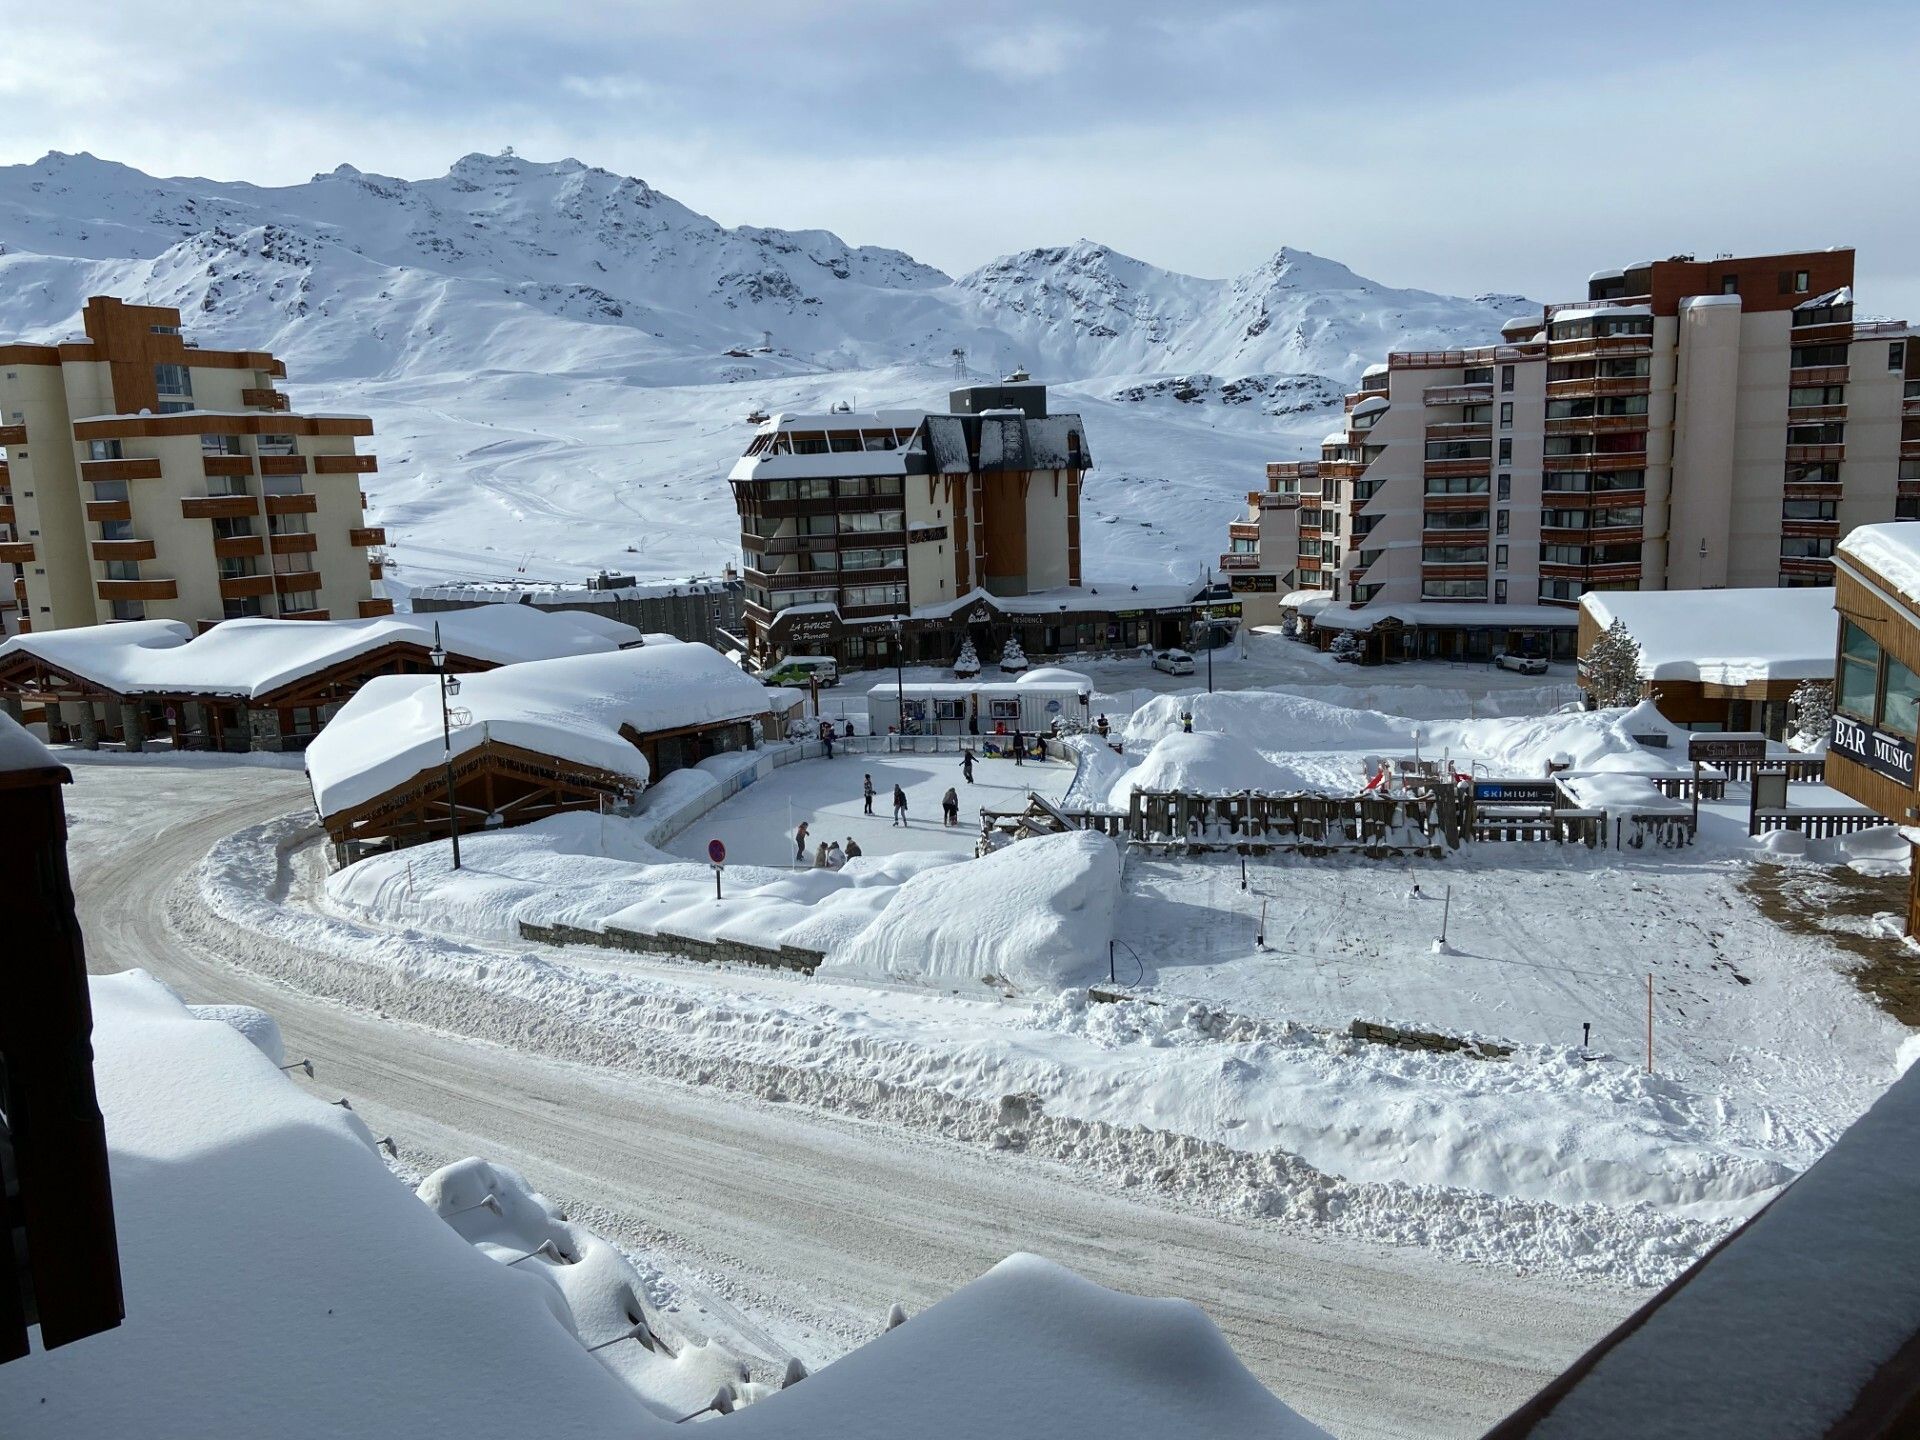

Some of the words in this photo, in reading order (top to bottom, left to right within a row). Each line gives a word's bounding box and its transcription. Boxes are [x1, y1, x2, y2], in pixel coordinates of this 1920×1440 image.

[1155, 605, 1192, 616] Supermarket
[1013, 616, 1043, 624] RESIDENCE
[789, 623, 801, 632] LA
[803, 621, 832, 630] PAUSE
[924, 621, 944, 629] HOTEL
[1834, 719, 1866, 756] BAR
[1874, 738, 1913, 772] MUSIC
[1483, 790, 1536, 798] SKIMIUM
